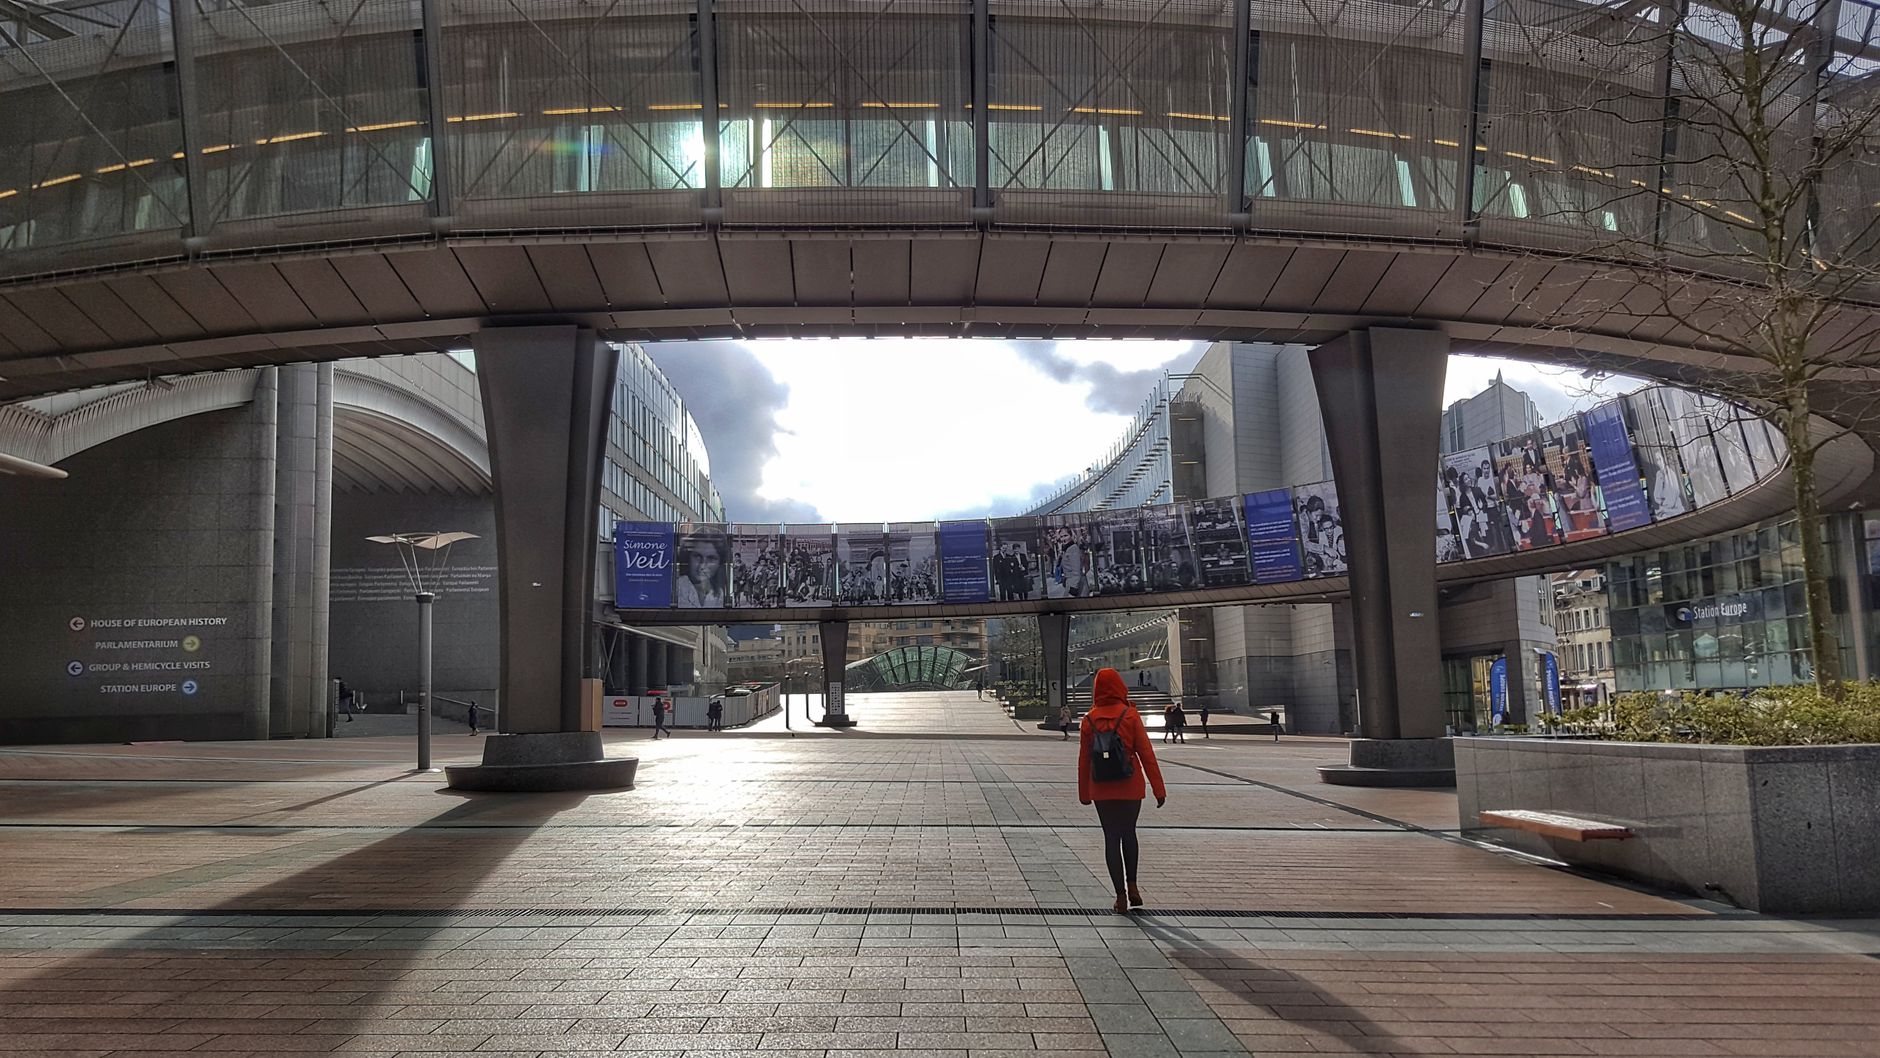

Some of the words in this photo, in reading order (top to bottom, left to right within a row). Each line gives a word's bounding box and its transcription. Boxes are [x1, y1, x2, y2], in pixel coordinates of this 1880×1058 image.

[624, 539, 668, 550] Simone
[624, 550, 670, 570] Veil
[1693, 606, 1719, 620] Station
[1720, 602, 1748, 617] Europe
[90, 619, 122, 628] HOUSE
[123, 619, 137, 627] OF
[138, 618, 187, 627] EUROPEAN
[188, 617, 228, 626] HISTORY
[95, 640, 178, 650] PARLAMENTARIUM
[88, 663, 121, 672] GROUP
[122, 663, 130, 671] &
[131, 661, 182, 671] HEMICYCLE
[183, 660, 211, 670] VISITS
[100, 684, 139, 694] STATION
[140, 683, 177, 693] EUROPE
